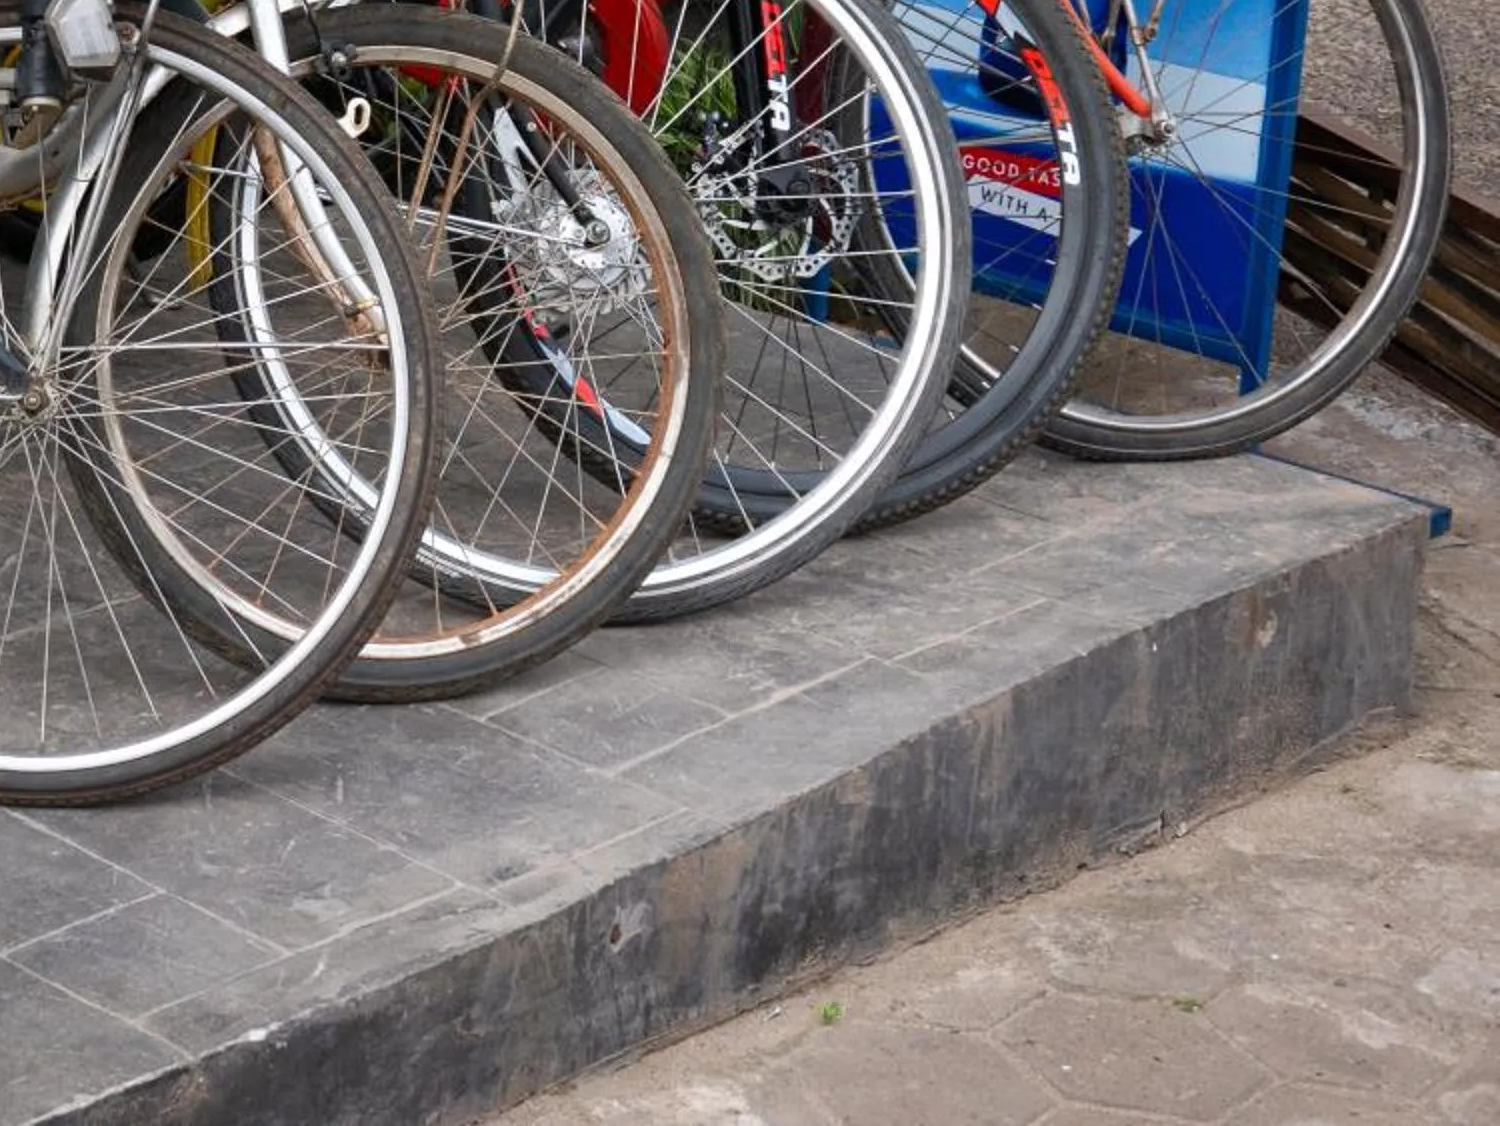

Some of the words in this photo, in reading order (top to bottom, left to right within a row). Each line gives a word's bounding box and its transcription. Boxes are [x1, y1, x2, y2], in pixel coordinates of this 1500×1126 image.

[963, 154, 1020, 178] GOOD
[981, 186, 1029, 215] WITH
[1037, 206, 1048, 222] A
